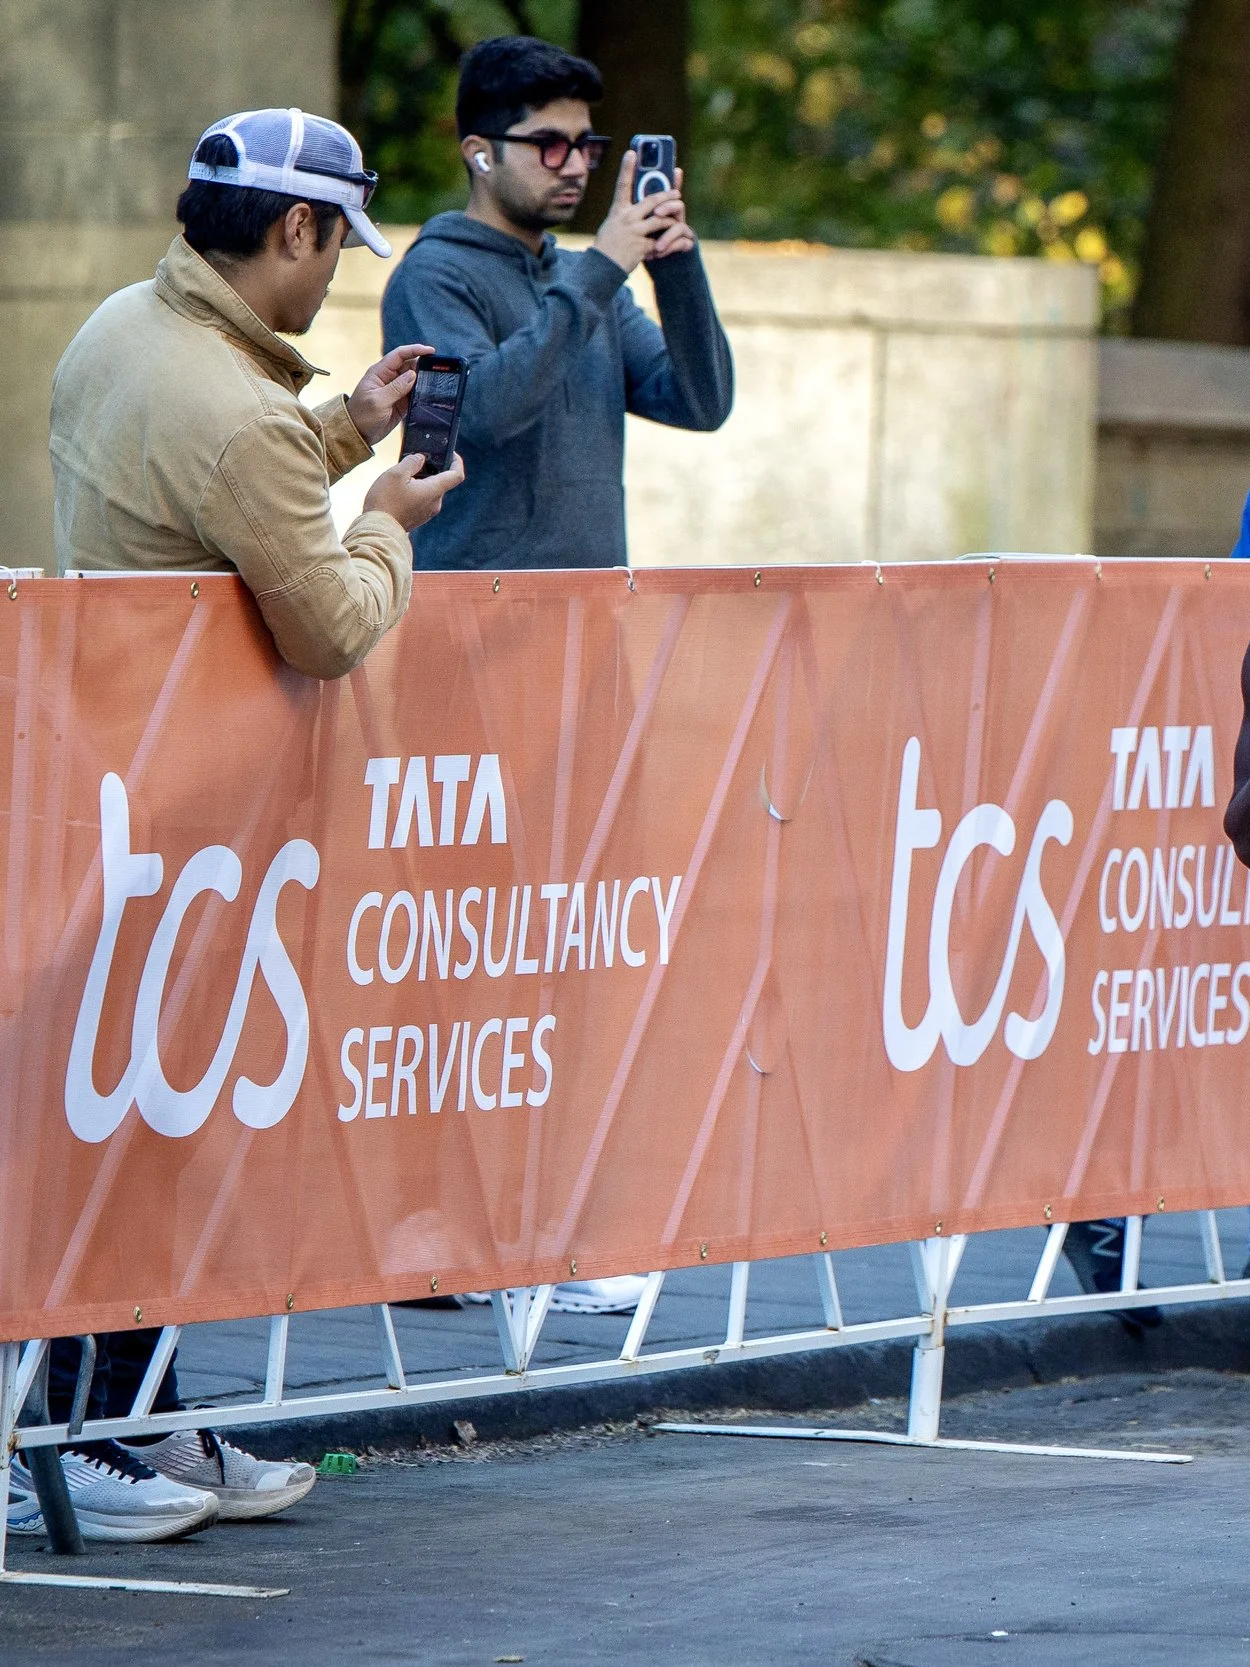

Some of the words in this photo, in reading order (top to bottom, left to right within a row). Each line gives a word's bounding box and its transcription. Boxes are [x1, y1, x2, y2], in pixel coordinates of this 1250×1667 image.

[364, 754, 507, 849] TATA
[1110, 725, 1215, 811] TATA
[64, 772, 320, 1143] tcs
[346, 876, 683, 986] CONSULTANCY
[882, 736, 1074, 1073] tcs
[337, 1014, 557, 1122] SERVICES
